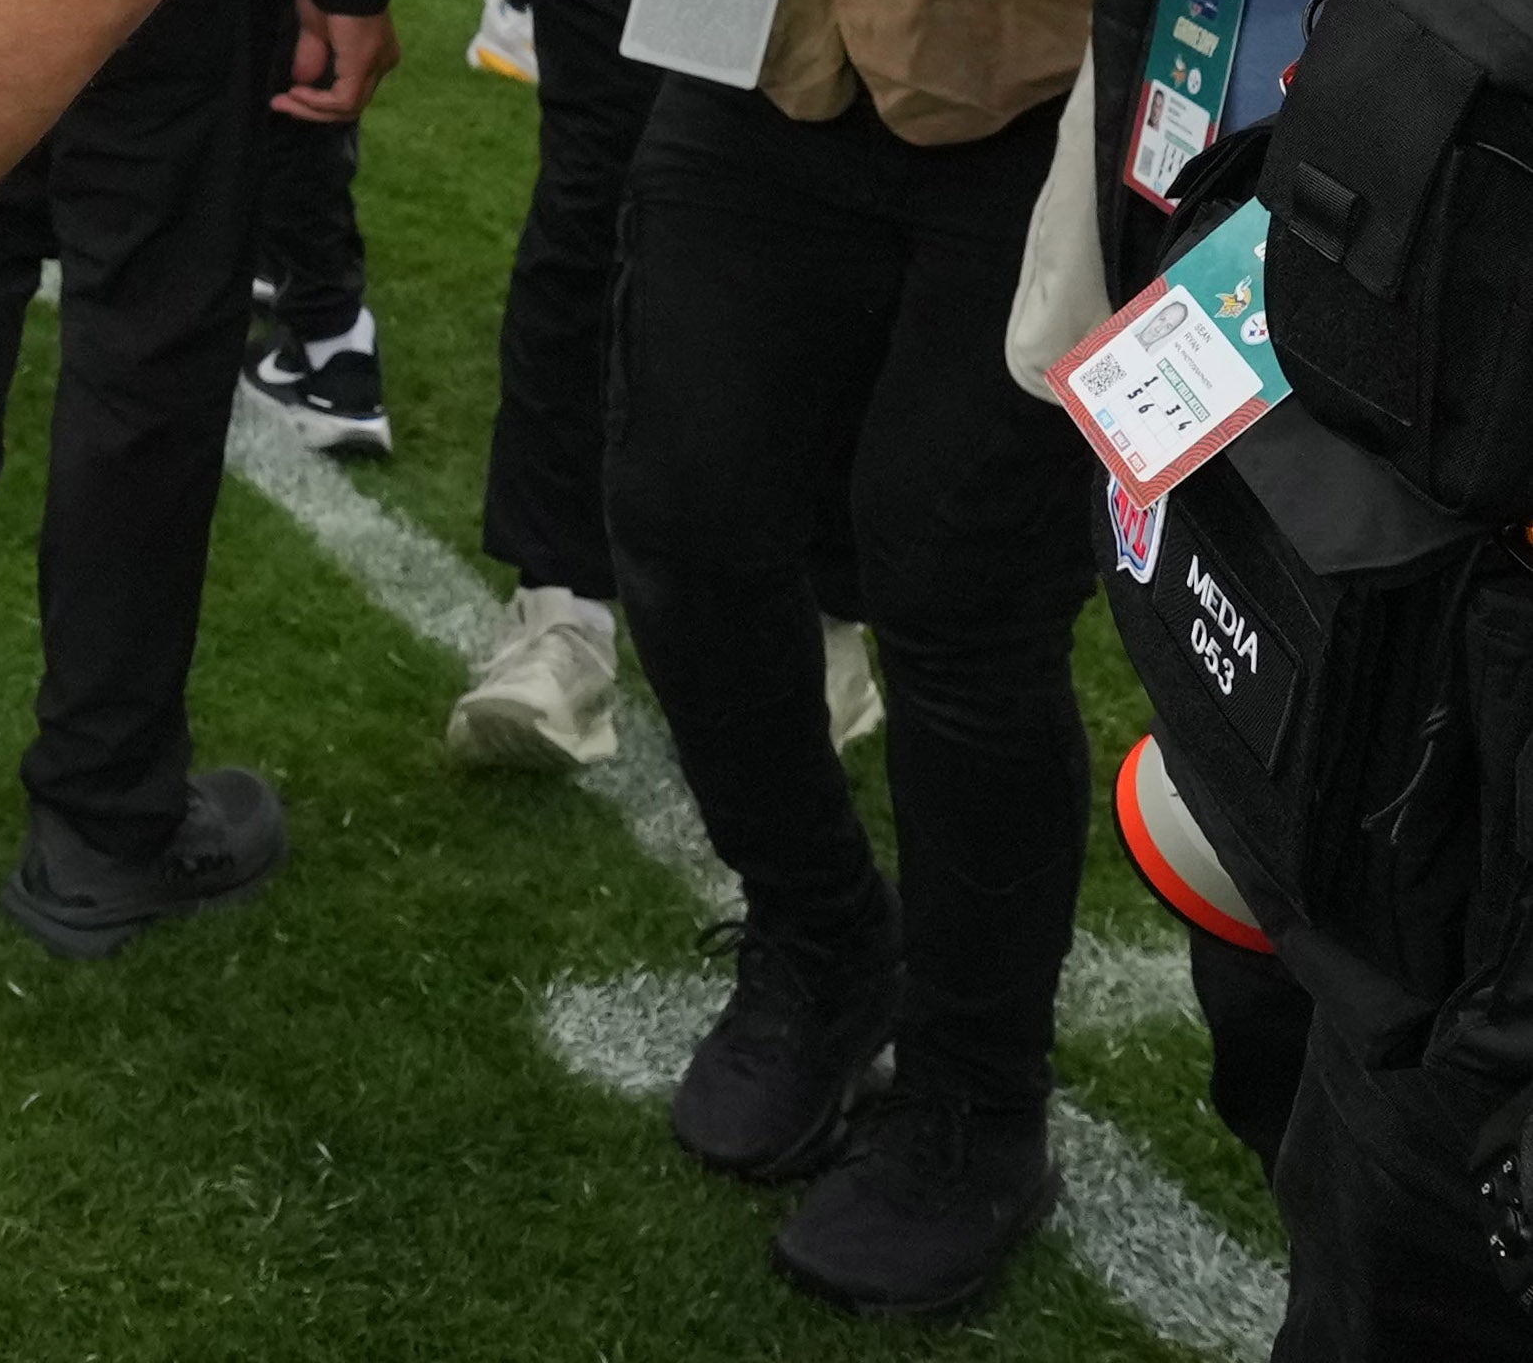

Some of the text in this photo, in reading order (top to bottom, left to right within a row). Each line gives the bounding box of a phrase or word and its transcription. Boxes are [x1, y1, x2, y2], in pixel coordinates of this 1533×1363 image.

[1183, 333, 1202, 352] RYAN
[1194, 323, 1214, 344] SEAN
[1127, 388, 1155, 414] 5 6
[1166, 404, 1181, 416] 3
[1177, 420, 1192, 431] 4
[1186, 554, 1259, 674] MEDIA
[1190, 617, 1235, 696] 053
